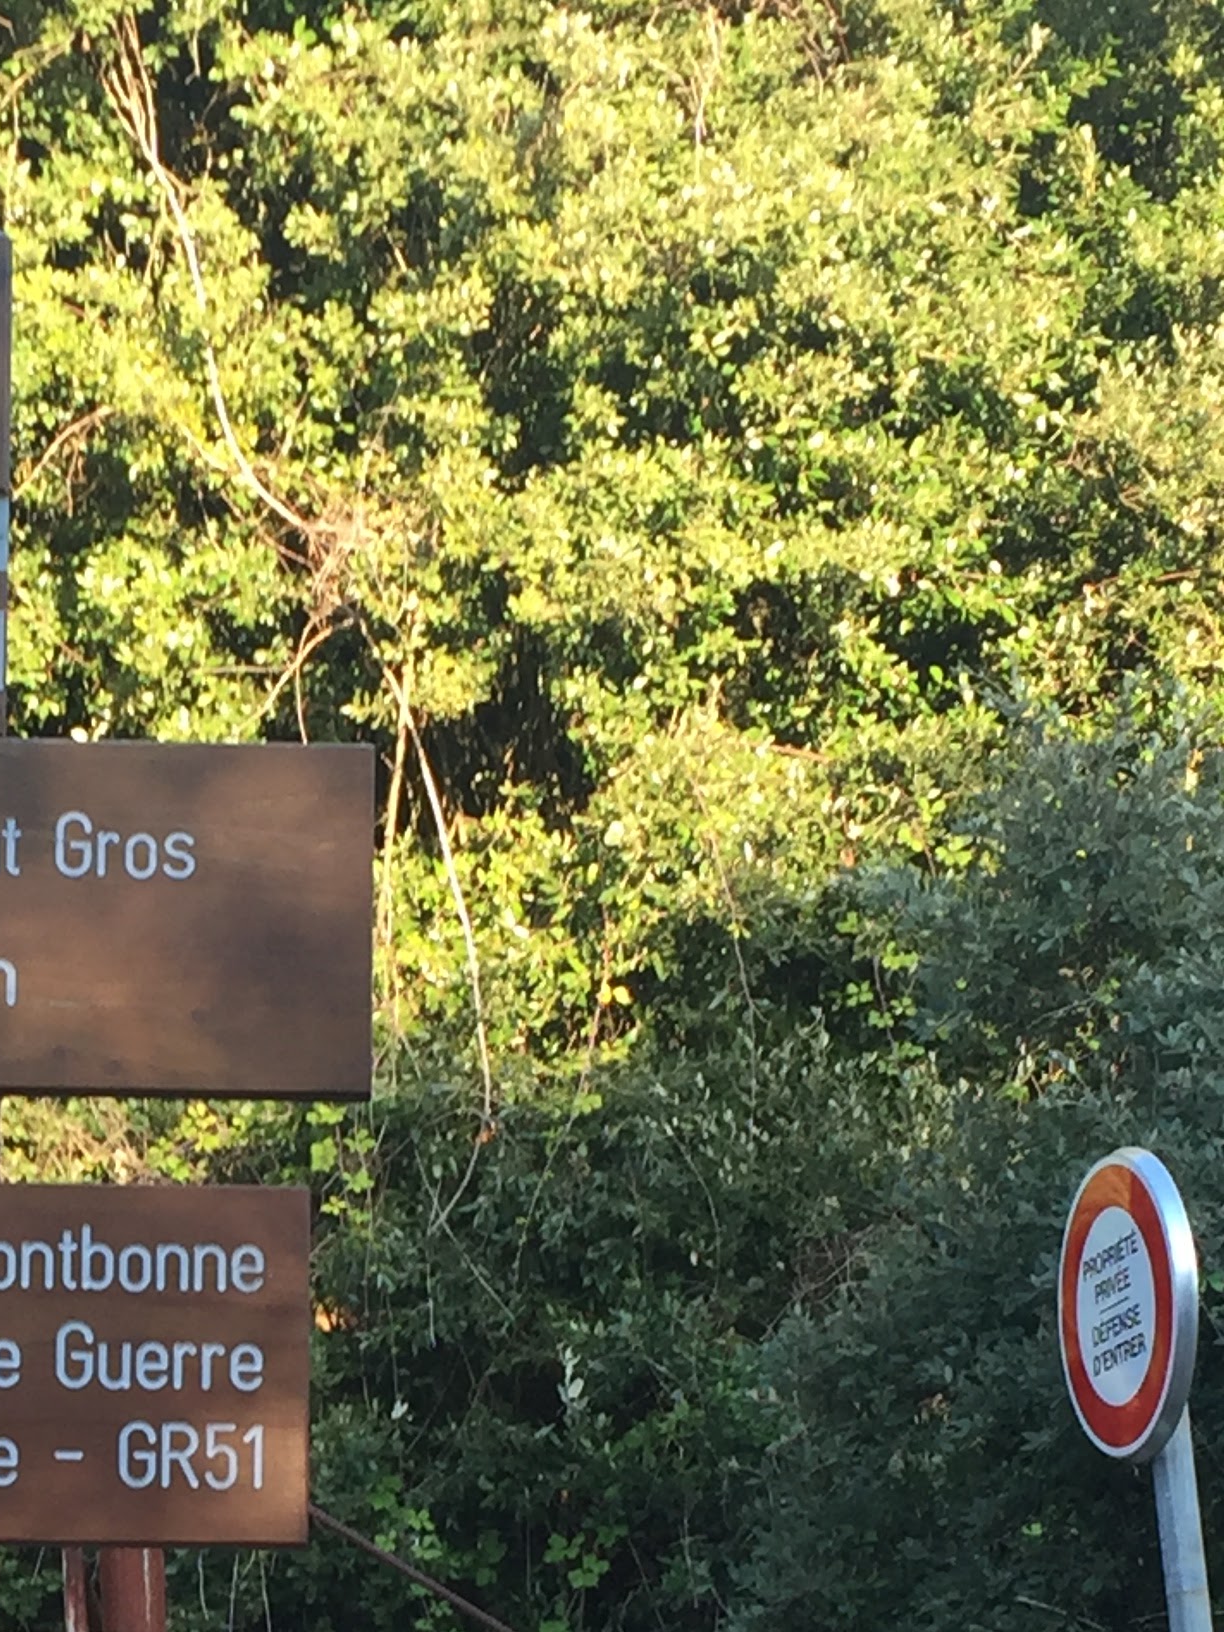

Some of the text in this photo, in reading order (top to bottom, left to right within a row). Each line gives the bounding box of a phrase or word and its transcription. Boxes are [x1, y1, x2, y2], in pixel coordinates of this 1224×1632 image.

[55, 810, 196, 880] Gros
[55, 1321, 264, 1391] Guerre
[117, 1420, 264, 1490] GR51
